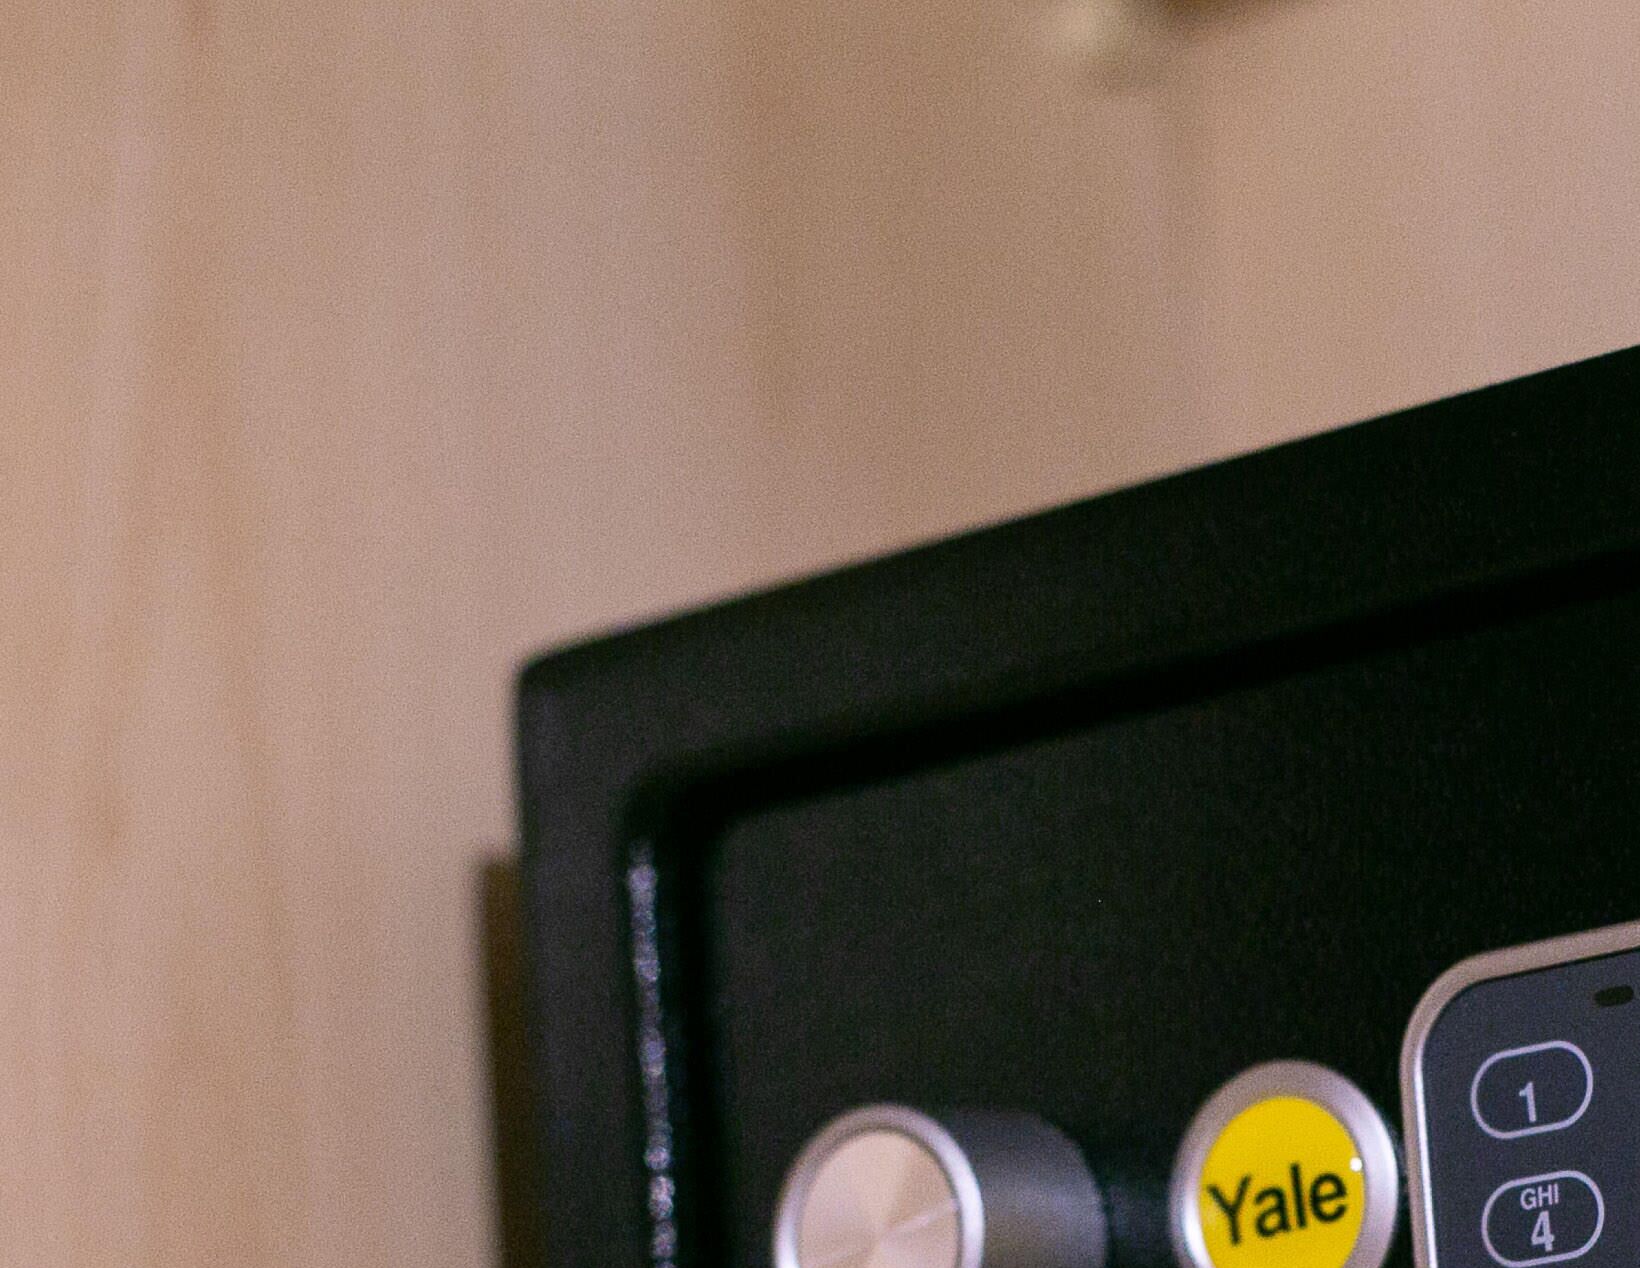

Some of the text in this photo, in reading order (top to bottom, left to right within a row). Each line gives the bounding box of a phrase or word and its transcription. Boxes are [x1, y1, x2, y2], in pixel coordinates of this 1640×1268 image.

[1519, 1082, 1536, 1122] 1
[1208, 1163, 1347, 1245] Yale
[1520, 1182, 1560, 1212] GHI
[1532, 1211, 1554, 1251] 4
